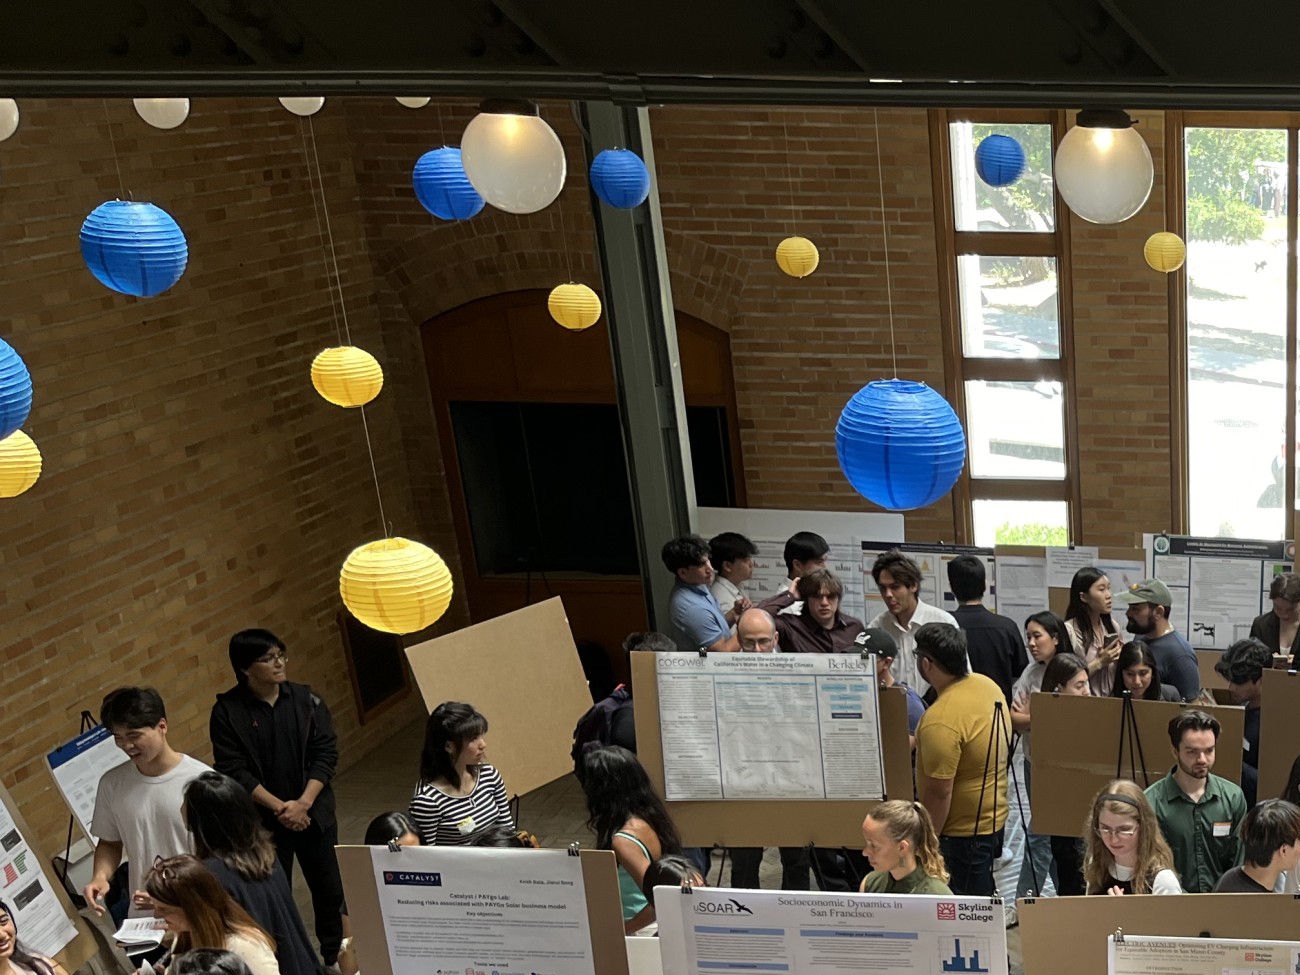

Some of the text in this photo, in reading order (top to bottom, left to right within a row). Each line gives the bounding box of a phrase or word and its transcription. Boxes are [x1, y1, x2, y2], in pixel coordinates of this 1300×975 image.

[828, 658, 869, 672] Berkeley
[399, 873, 440, 881] CATALYST
[397, 899, 425, 907] Reducing
[693, 902, 734, 913] uSOAR
[777, 897, 903, 910] Socioeconomic Dynamics in
[958, 903, 993, 913] Skyline
[810, 908, 875, 918] San Francisco:
[958, 913, 994, 922] College
